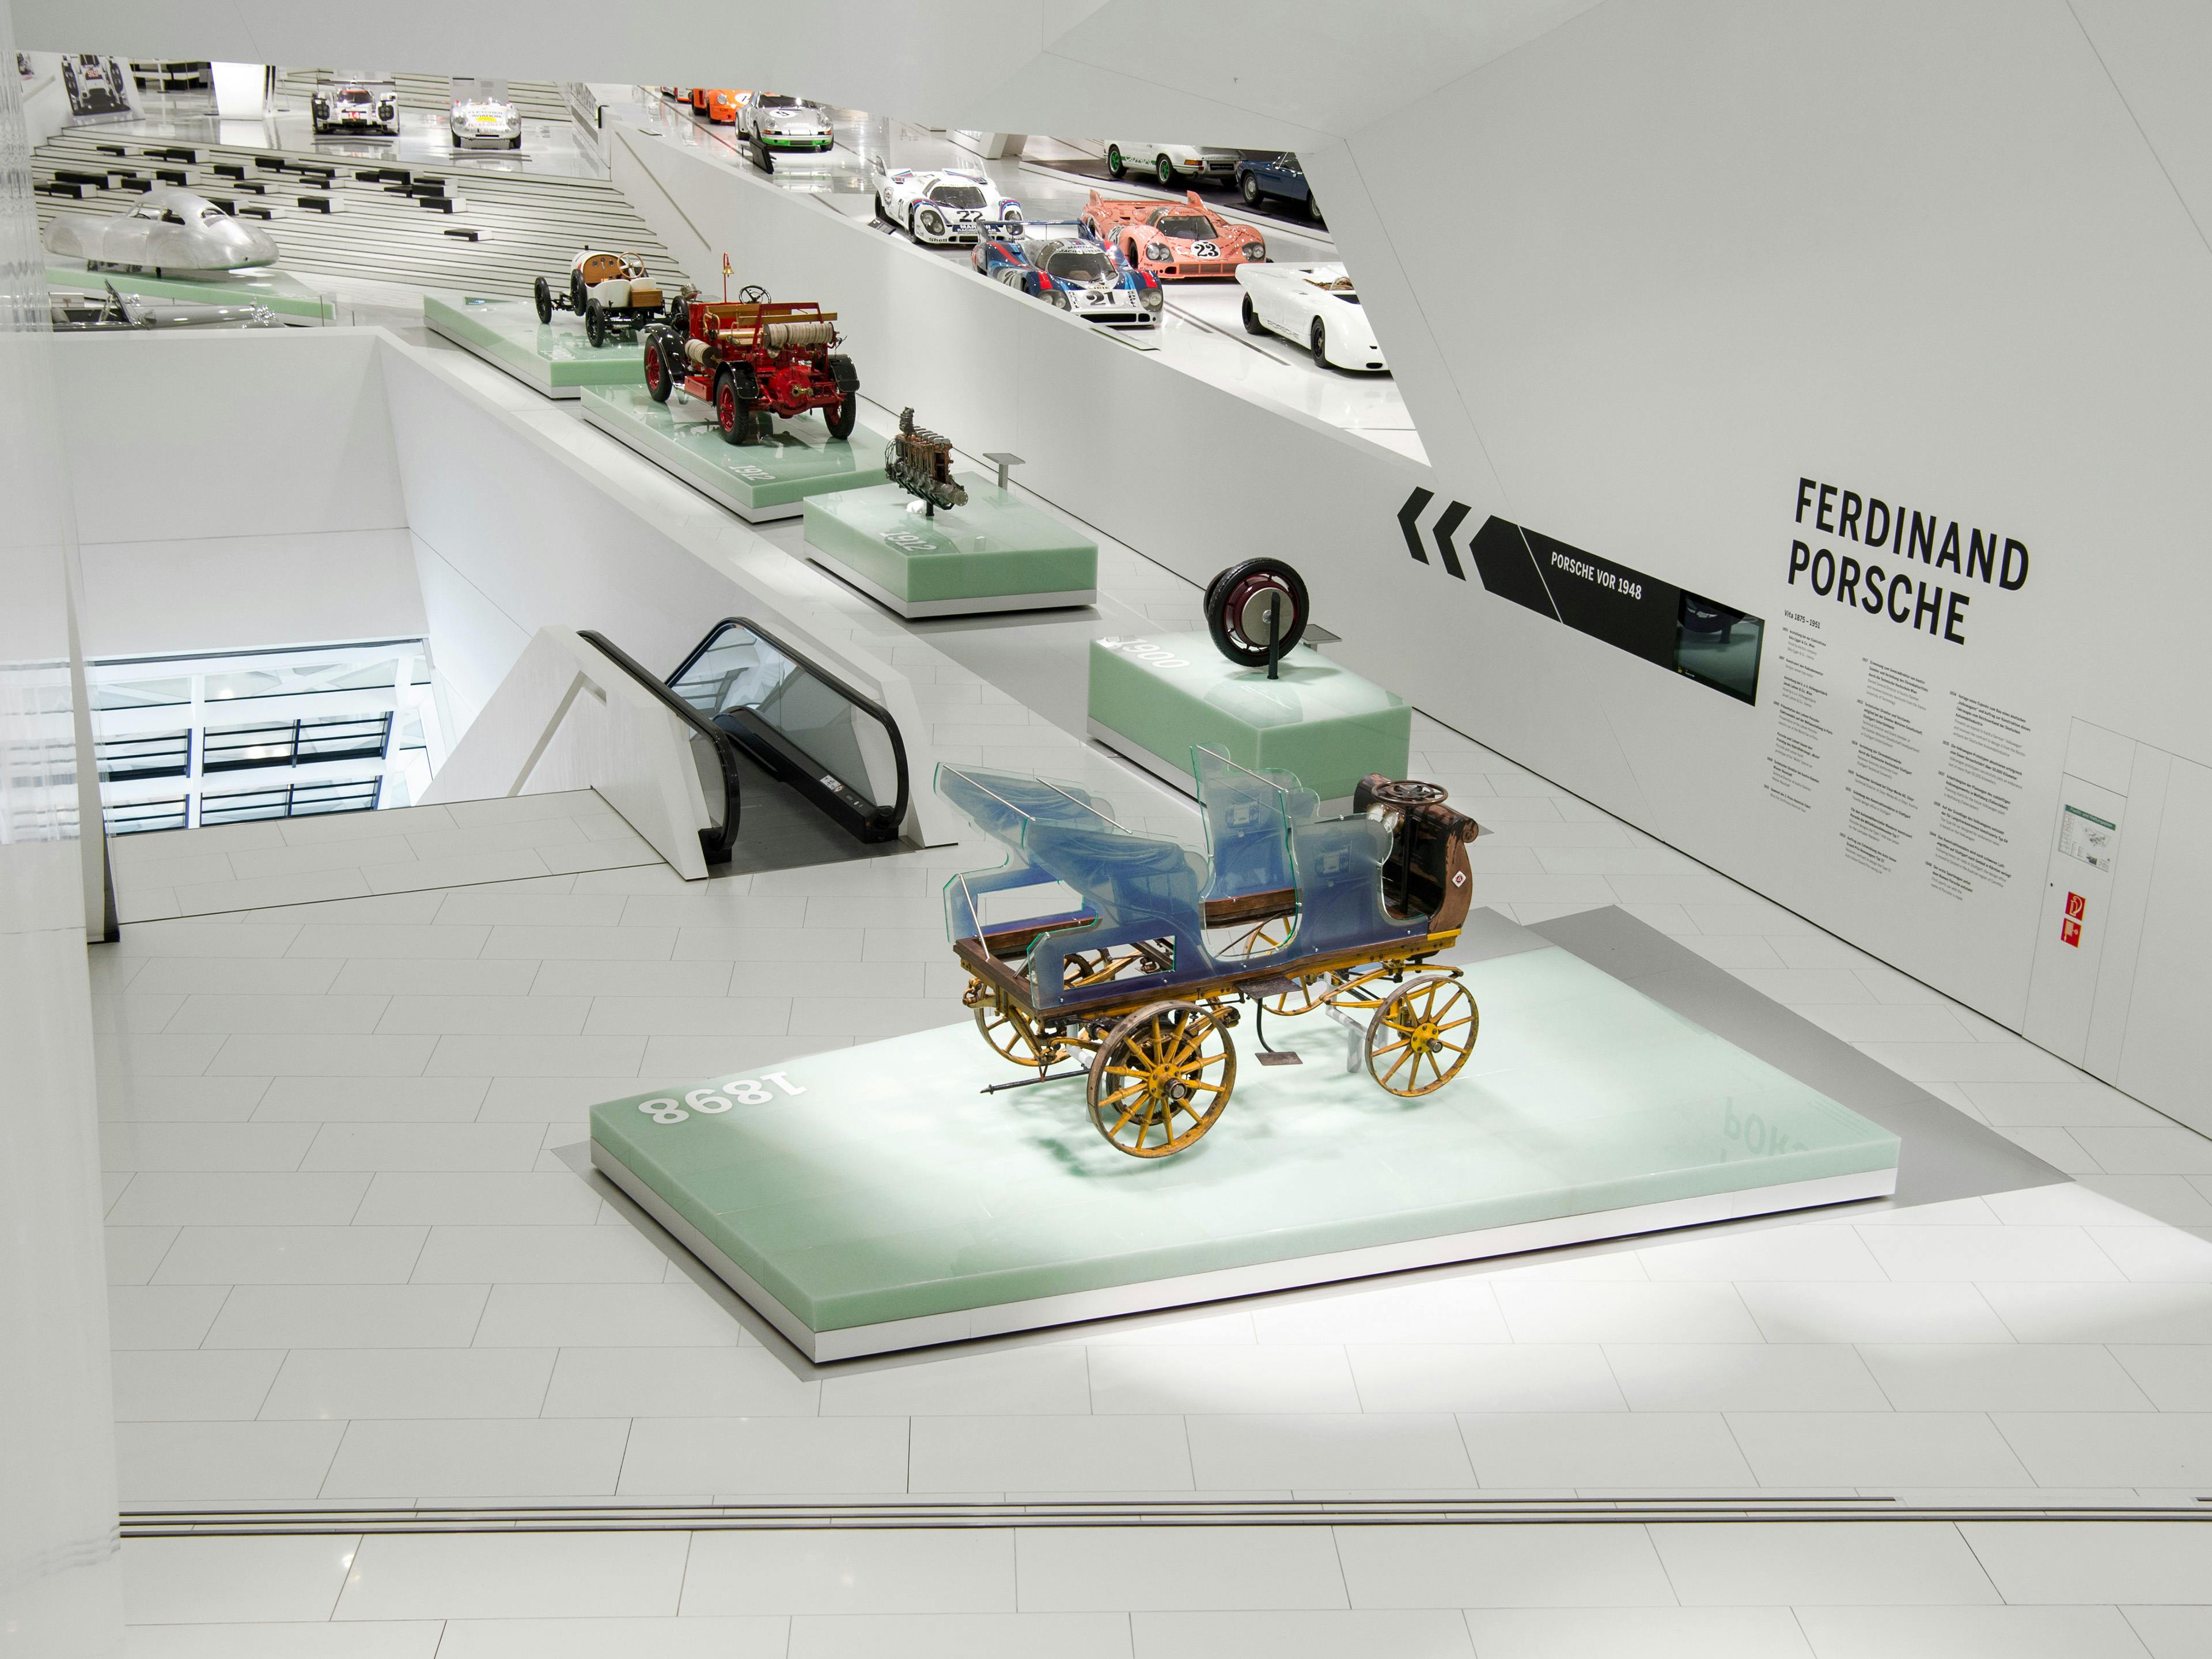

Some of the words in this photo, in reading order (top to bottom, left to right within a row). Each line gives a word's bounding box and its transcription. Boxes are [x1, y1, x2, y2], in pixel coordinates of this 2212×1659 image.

[956, 210, 986, 222] 22
[1194, 243, 1219, 257] 23
[1086, 290, 1116, 306] 21
[1267, 320, 1300, 340] PORSCHE
[728, 465, 776, 481] 1912
[878, 531, 937, 551] 1912
[1794, 476, 2030, 592] FERDINAND
[1551, 551, 1595, 581] PORSCHE
[1597, 569, 1616, 590] VOR
[1618, 578, 1642, 600] 1948
[1787, 539, 1971, 646] PORSCHE
[1784, 609, 1793, 619] Vita
[1794, 613, 1805, 623] 1875
[1809, 619, 1820, 629] 1951
[1096, 637, 1191, 668] 1900
[638, 1071, 808, 1124] 1898
